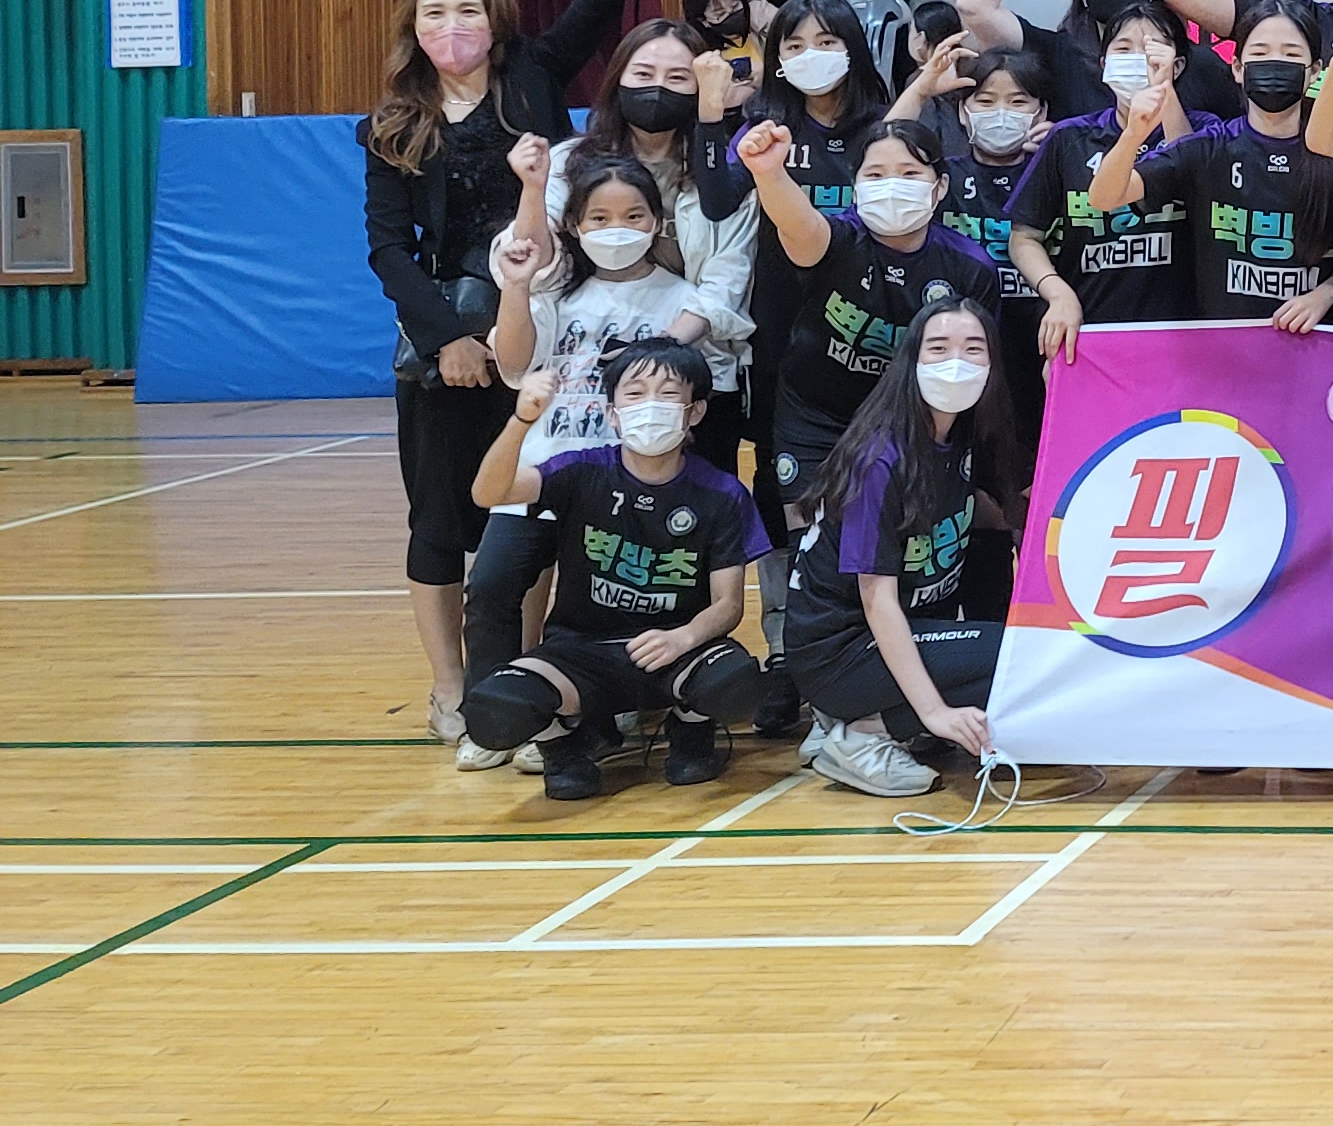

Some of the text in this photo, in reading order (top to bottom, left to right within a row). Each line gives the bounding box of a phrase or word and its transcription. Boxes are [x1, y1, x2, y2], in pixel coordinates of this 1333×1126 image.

[1231, 162, 1243, 189] 6
[611, 490, 625, 516] 7
[584, 523, 698, 587] 벽방초
[1092, 455, 1241, 620] 필
